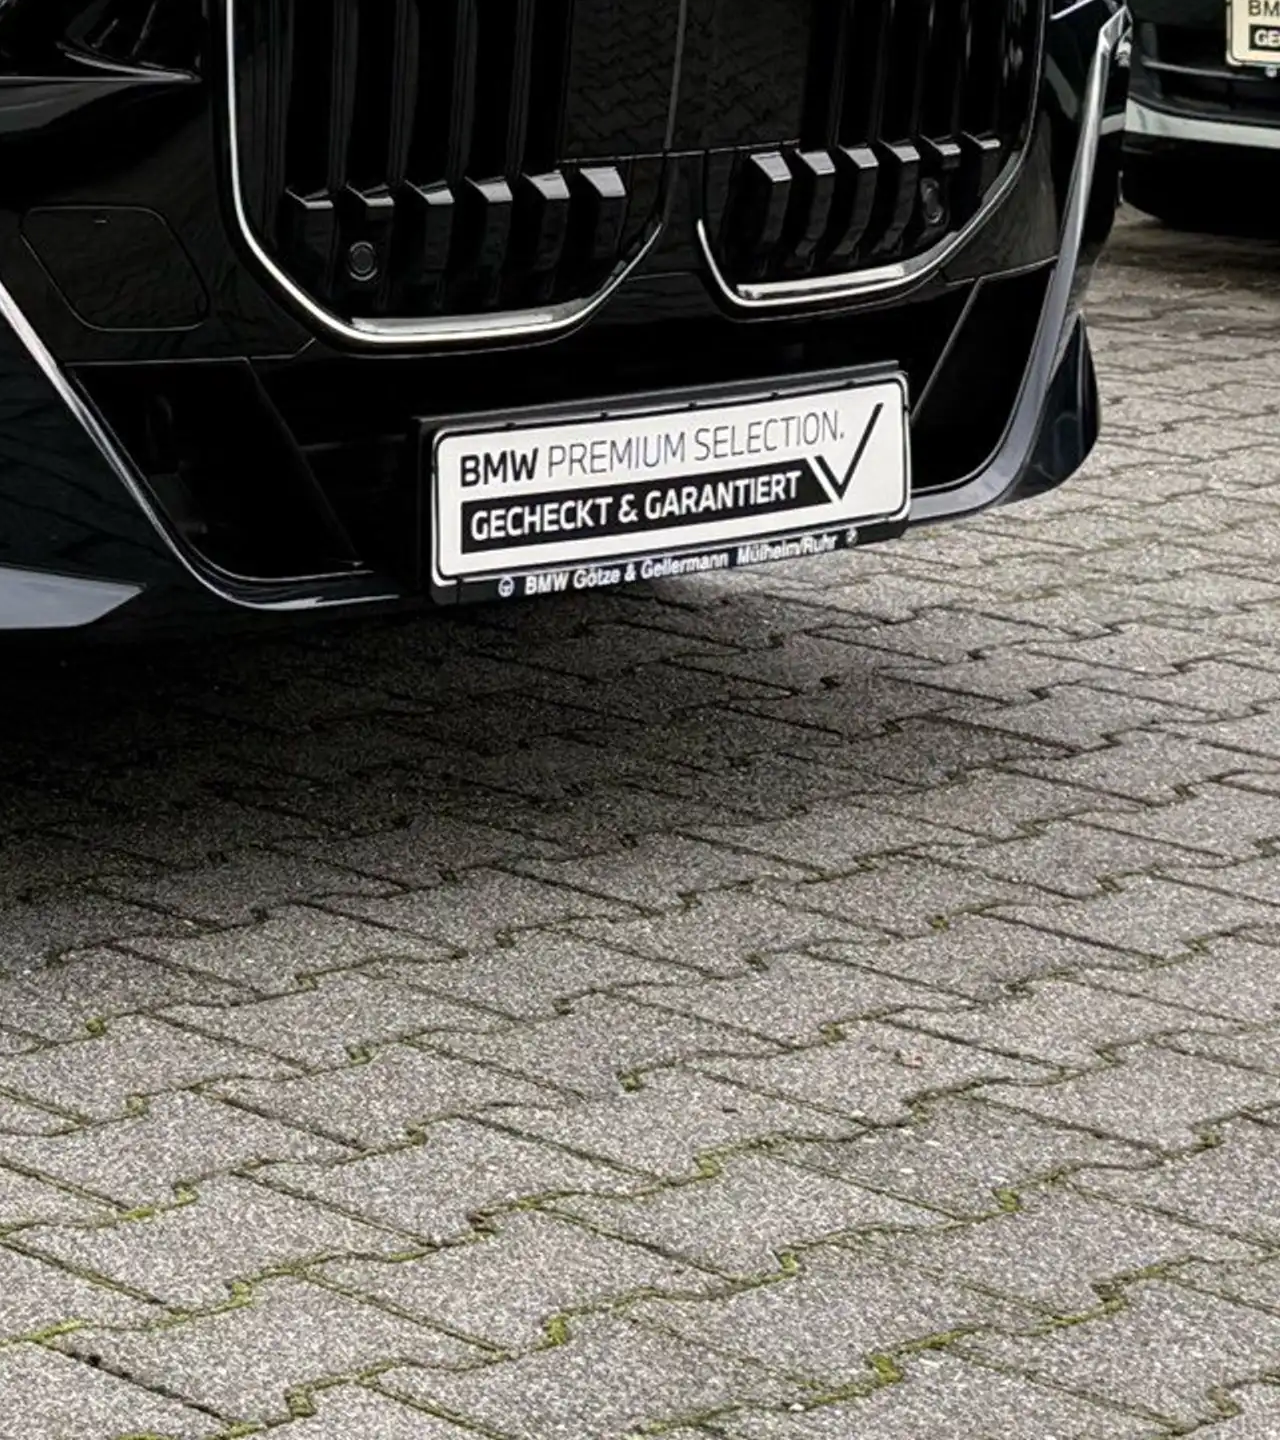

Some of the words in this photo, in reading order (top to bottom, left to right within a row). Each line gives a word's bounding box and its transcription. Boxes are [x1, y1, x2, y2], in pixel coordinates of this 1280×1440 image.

[460, 446, 540, 488] BMW
[548, 429, 686, 478] PREMIUM
[470, 496, 614, 541] GECHECKT
[619, 493, 639, 523] &
[644, 469, 802, 519] GARANTIERT
[524, 571, 570, 596] BMW
[573, 565, 621, 590] Götze
[624, 562, 637, 582] &
[641, 551, 730, 580] Gellermann
